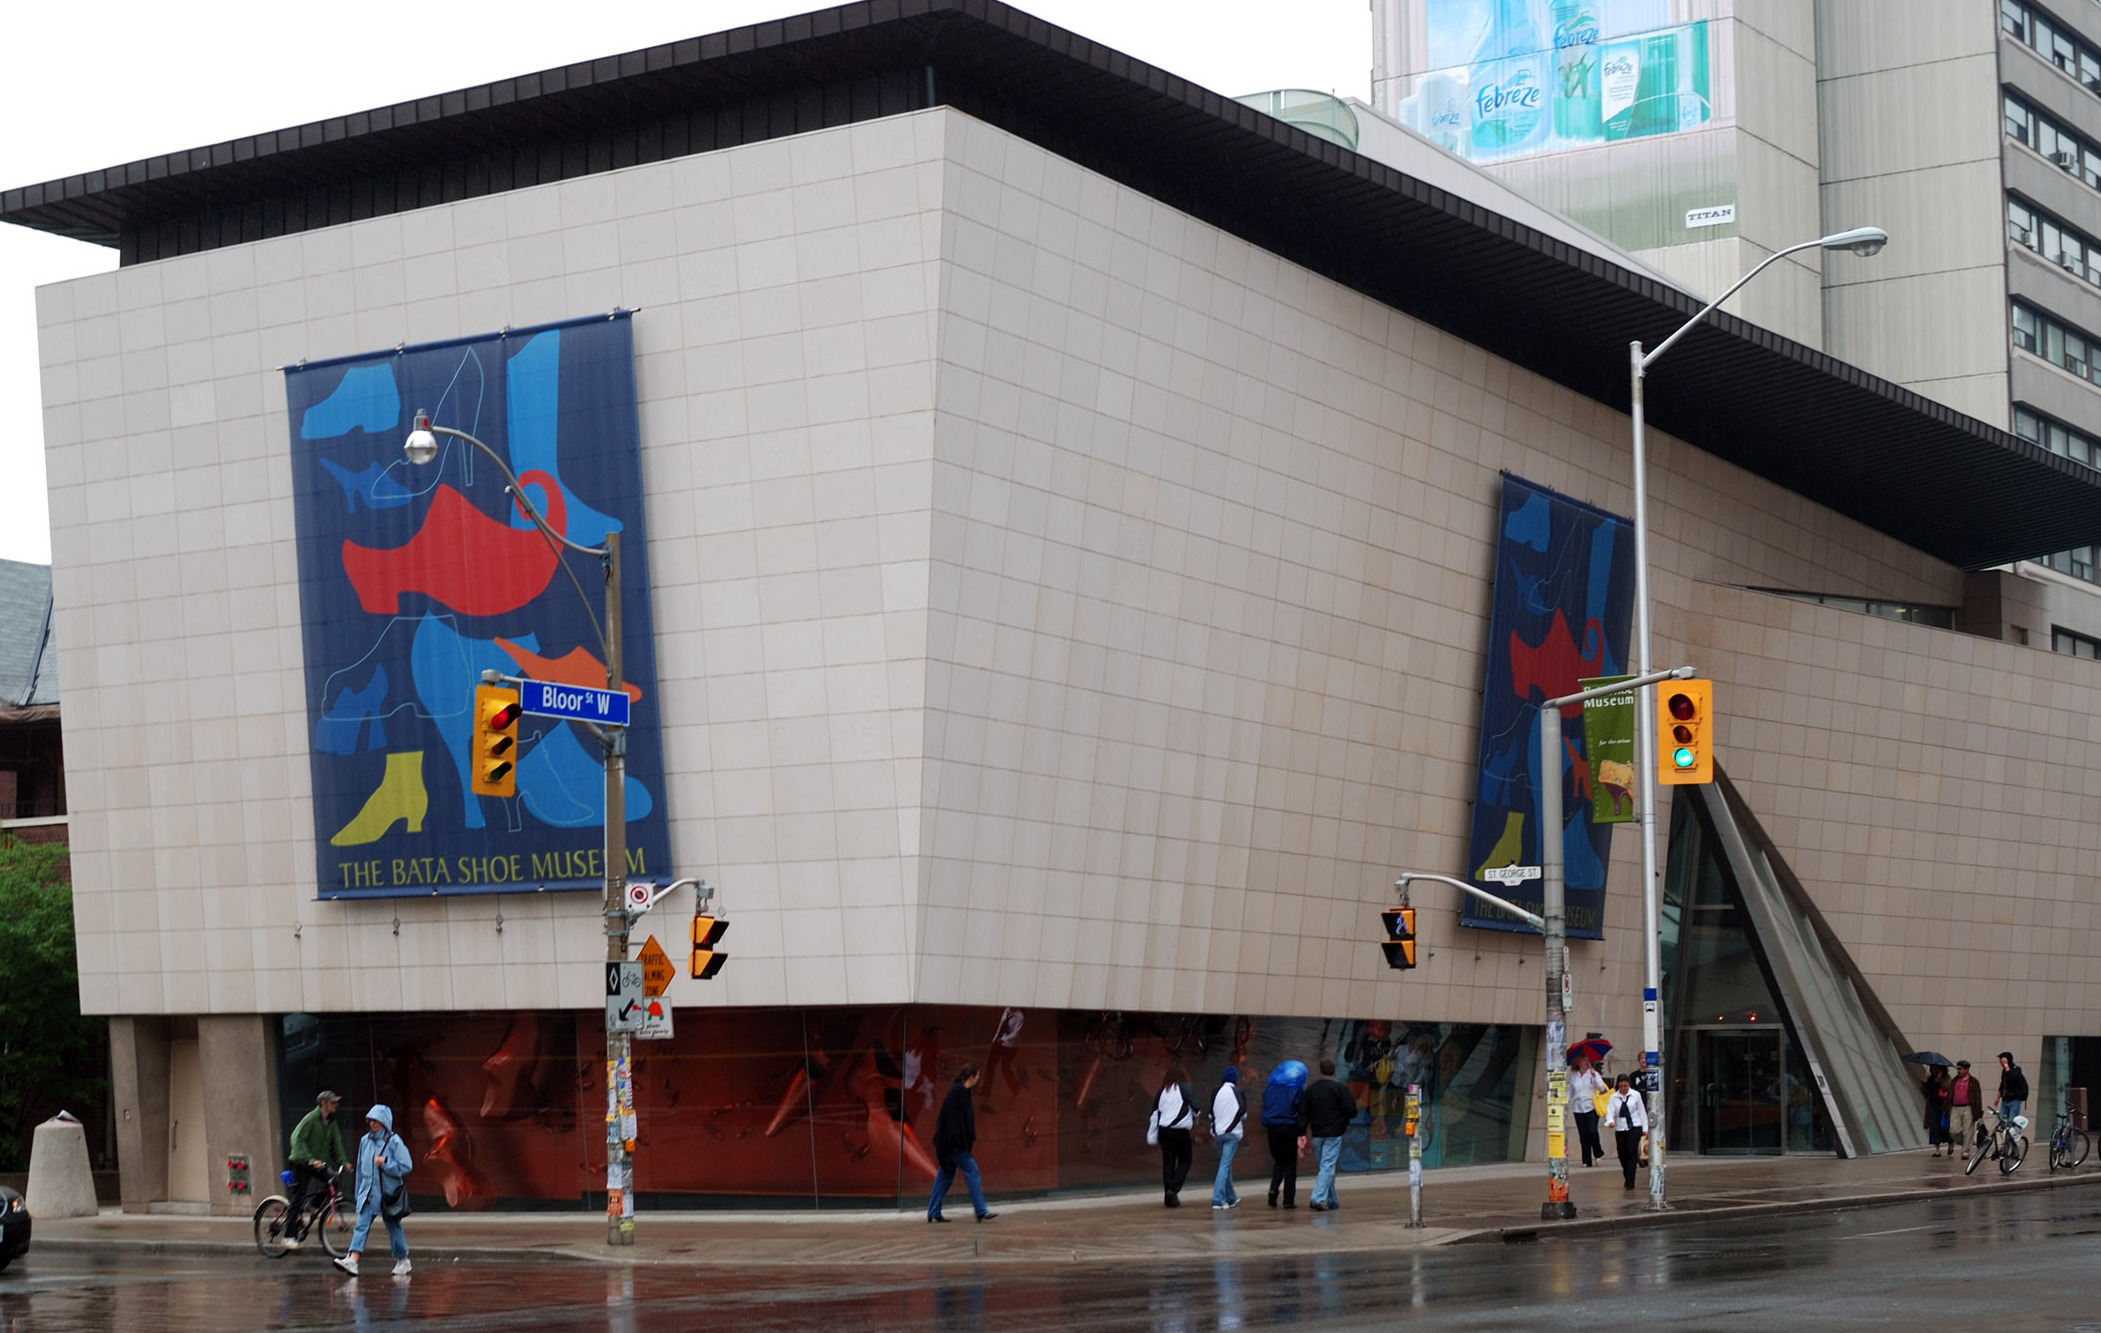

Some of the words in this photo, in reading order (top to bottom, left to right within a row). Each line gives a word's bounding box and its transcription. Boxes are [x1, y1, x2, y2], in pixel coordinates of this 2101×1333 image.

[1687, 208, 1732, 221] TITAN
[542, 686, 584, 711] Bloor
[585, 692, 594, 704] St
[597, 693, 610, 715] W
[1583, 695, 1634, 708] Museum
[338, 860, 384, 888] THE
[392, 857, 451, 885] BATA
[458, 854, 525, 884] SHOE
[532, 847, 647, 879] MUSEM
[1500, 868, 1526, 879] GEORGE
[643, 969, 665, 982] ALMING
